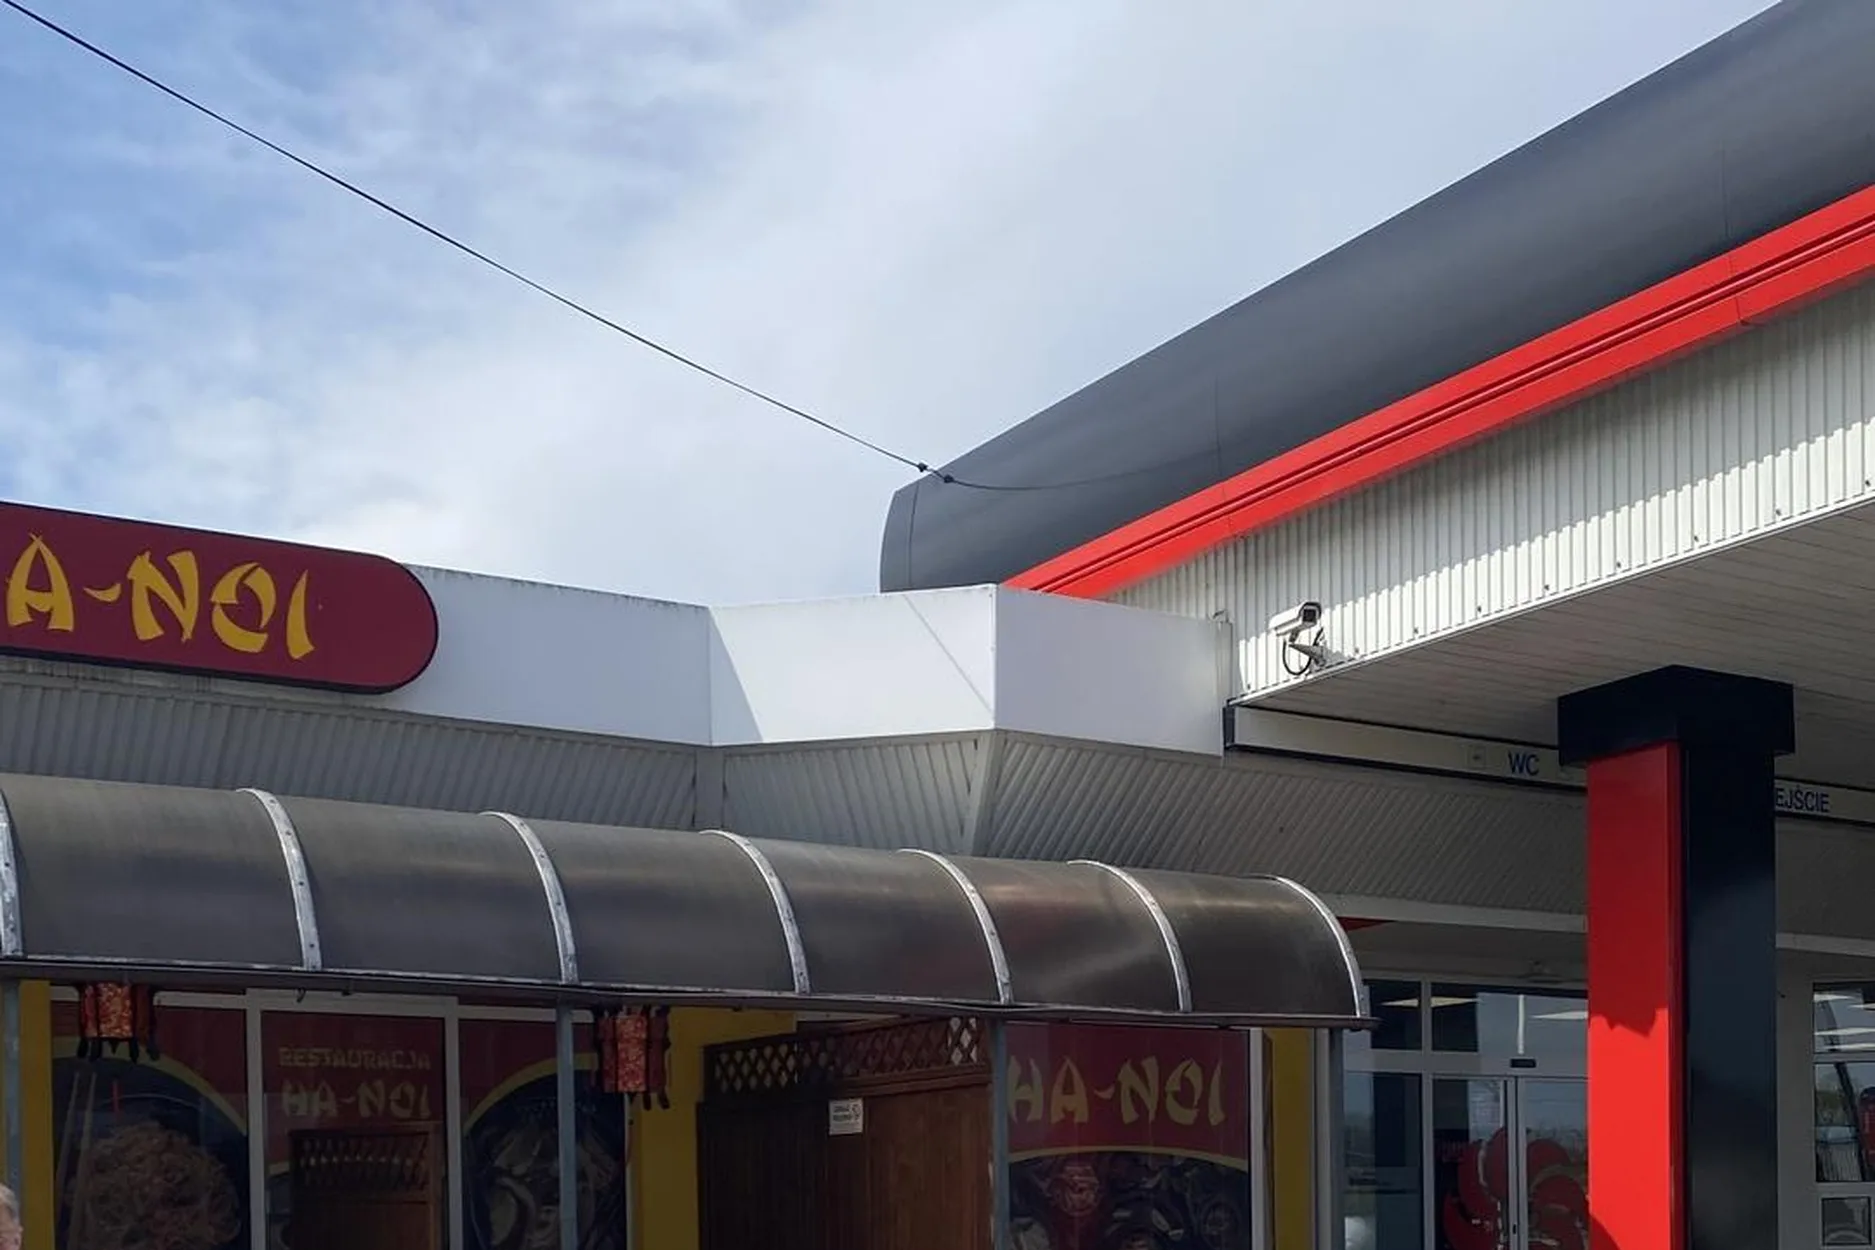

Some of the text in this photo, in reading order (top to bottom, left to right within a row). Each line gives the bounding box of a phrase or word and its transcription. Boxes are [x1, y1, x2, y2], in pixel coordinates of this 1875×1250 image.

[7, 533, 315, 660] A-NOI
[1508, 750, 1540, 776] WC
[1776, 785, 1830, 813] EJŚCIE
[279, 1047, 432, 1070] RESTAURACJA
[282, 1079, 432, 1119] HA-NOI
[1006, 1055, 1225, 1126] HA-NOI
